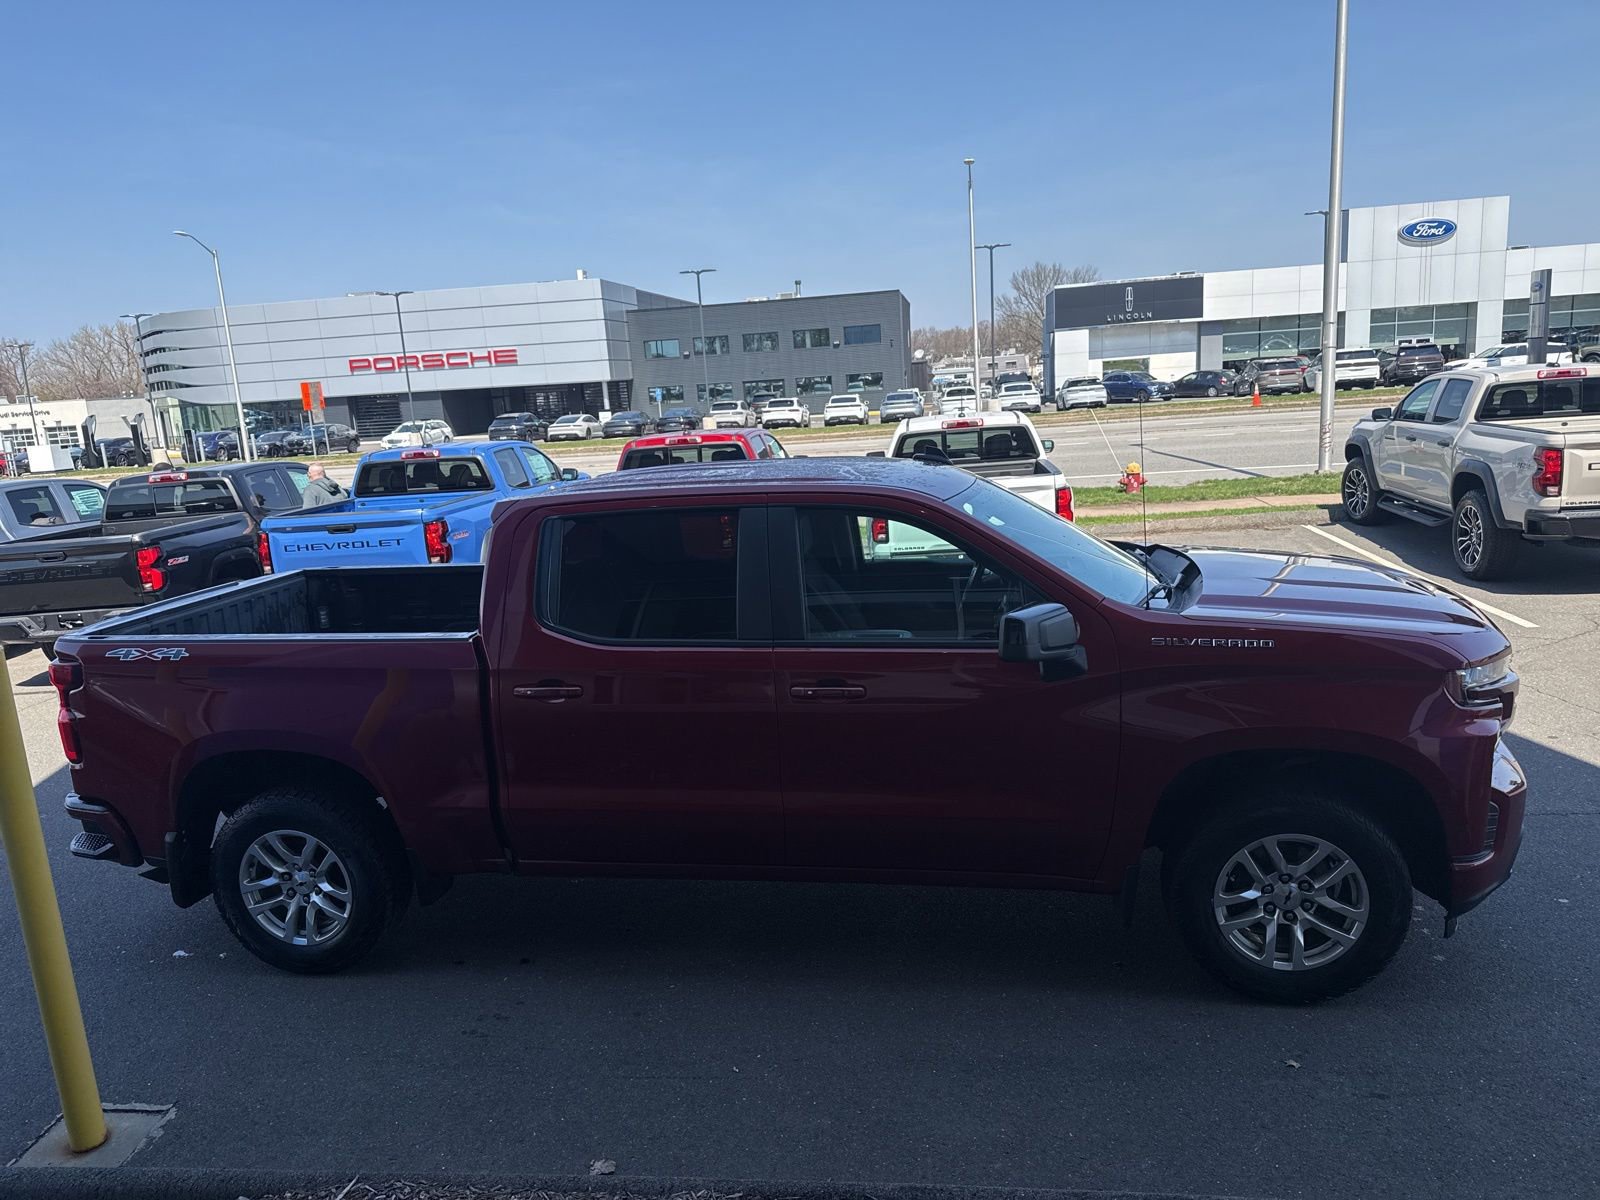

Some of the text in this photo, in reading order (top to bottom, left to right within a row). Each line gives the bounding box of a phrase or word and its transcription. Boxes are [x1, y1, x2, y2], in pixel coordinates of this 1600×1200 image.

[1412, 222, 1446, 237] Ford
[1106, 311, 1152, 321] LINCOLN
[348, 349, 518, 375] PORSCHE
[284, 538, 405, 553] CHEVROLET
[1151, 637, 1275, 648] SILVERADO
